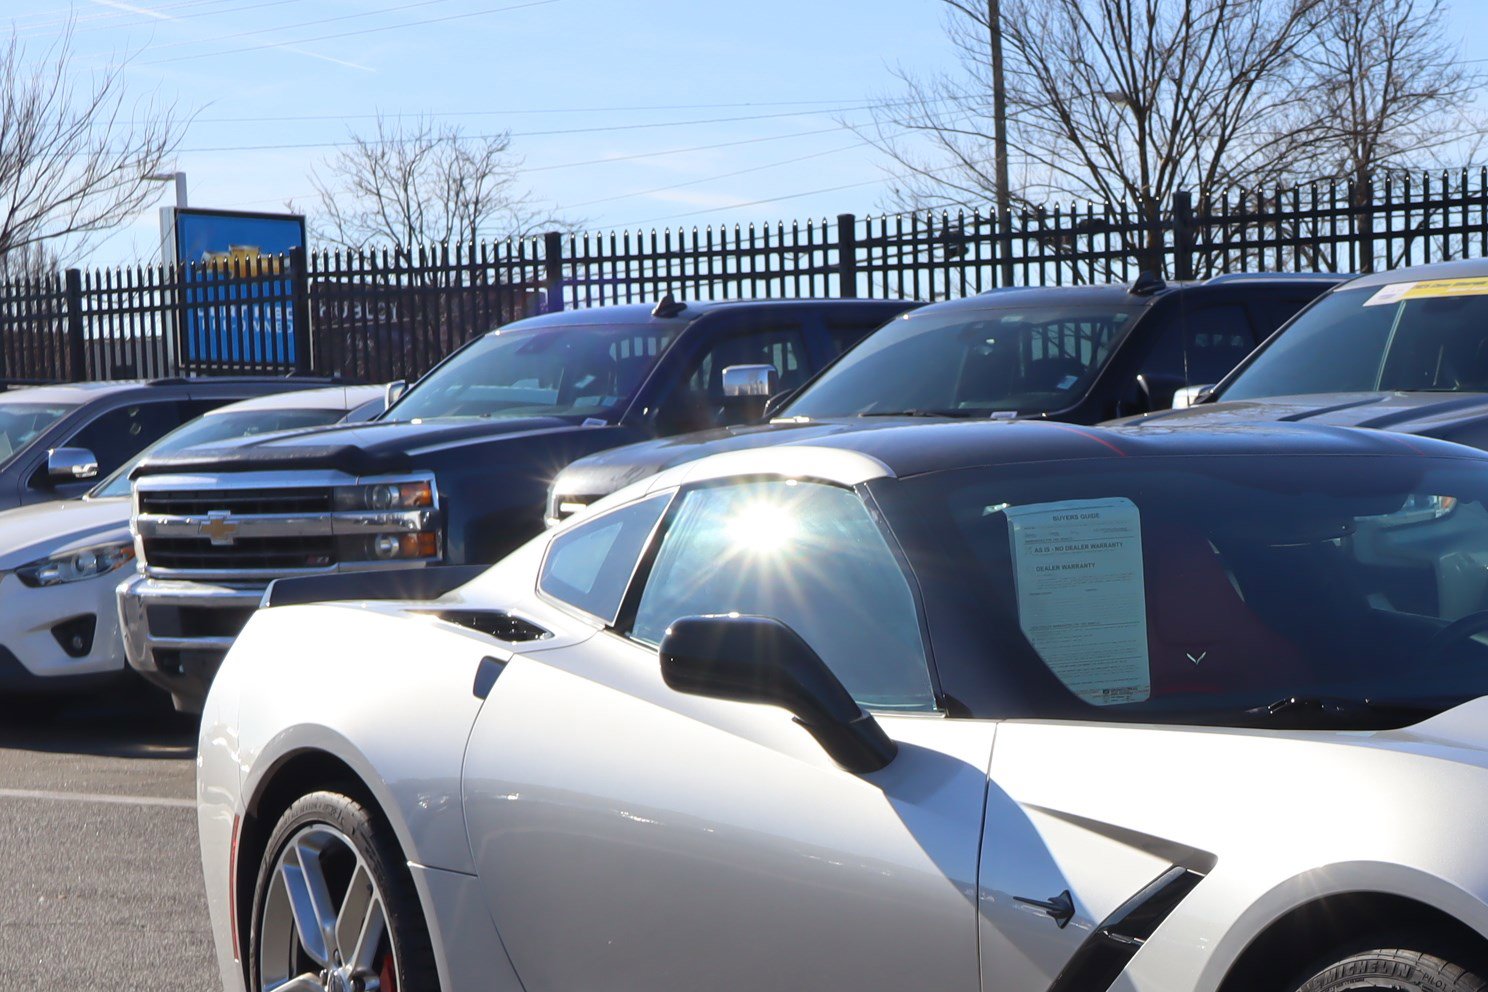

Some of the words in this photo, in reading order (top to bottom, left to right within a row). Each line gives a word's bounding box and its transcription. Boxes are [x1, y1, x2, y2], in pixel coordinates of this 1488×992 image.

[1052, 514, 1079, 522] BUYERS
[1080, 512, 1100, 520] GUIDE
[1090, 542, 1123, 550] WARRANTY
[1036, 564, 1060, 572] DEALER
[1061, 562, 1096, 570] WARRANTY
[1324, 959, 1412, 983] MICHELIN
[1422, 972, 1447, 992] PILOT
